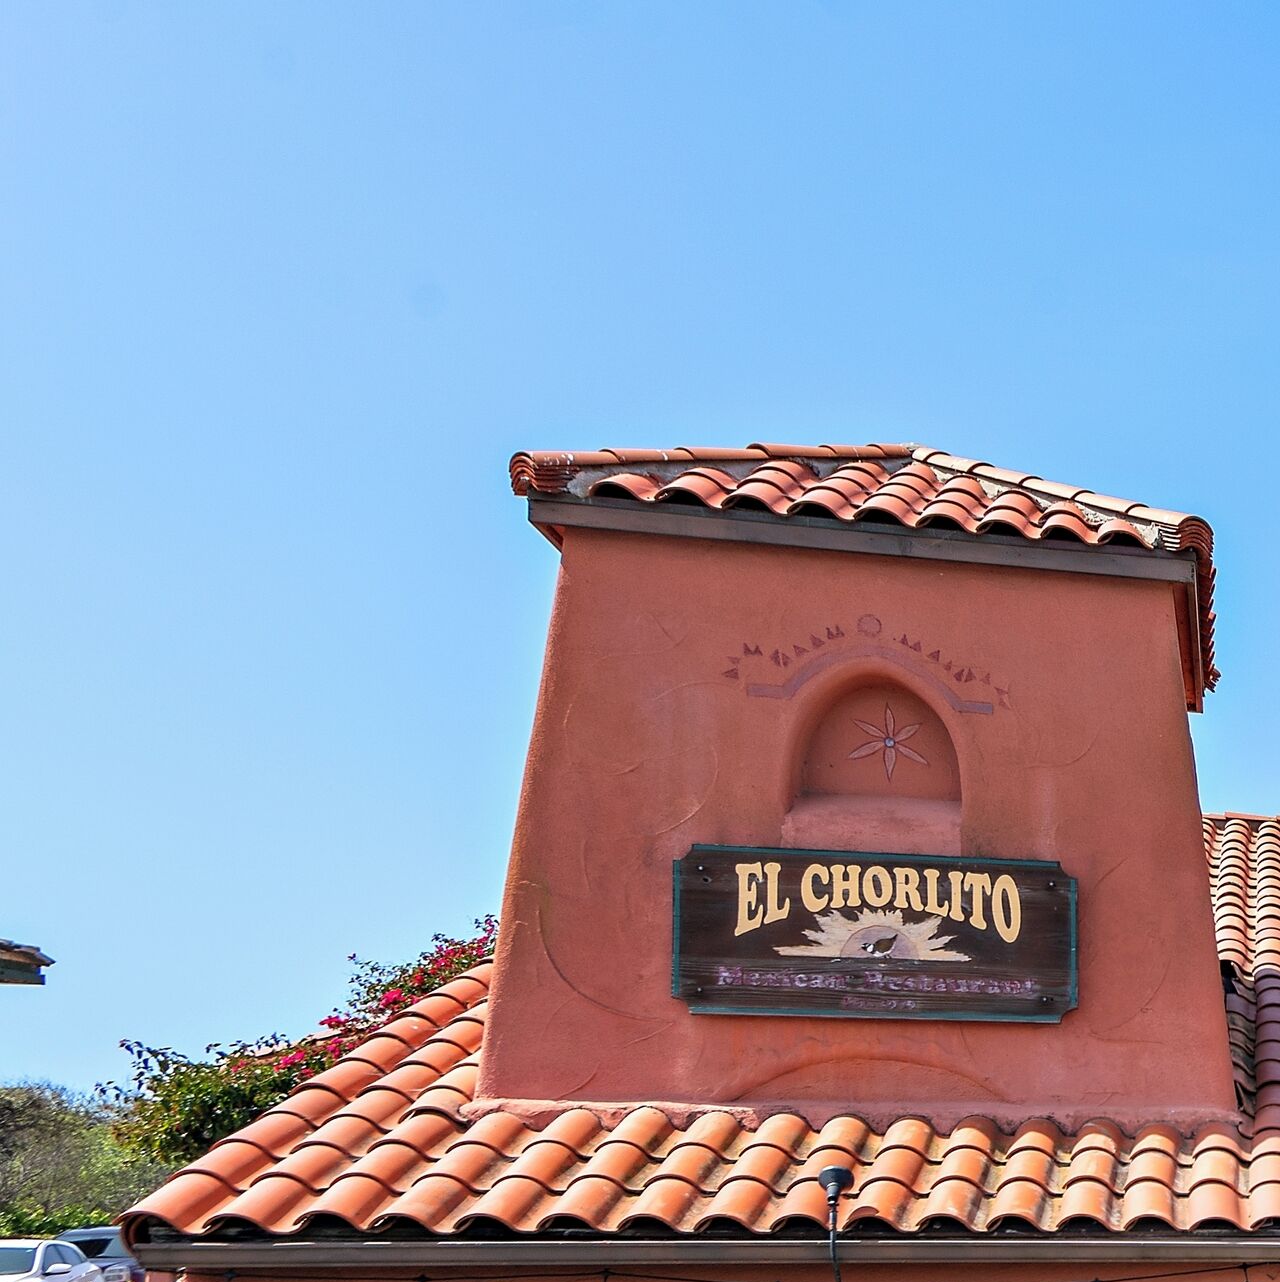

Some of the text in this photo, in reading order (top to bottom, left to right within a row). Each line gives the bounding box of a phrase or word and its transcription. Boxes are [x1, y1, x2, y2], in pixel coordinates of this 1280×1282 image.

[734, 862, 1021, 943] EL CHORLITO
[716, 964, 1037, 995] Mexican Restaurant
